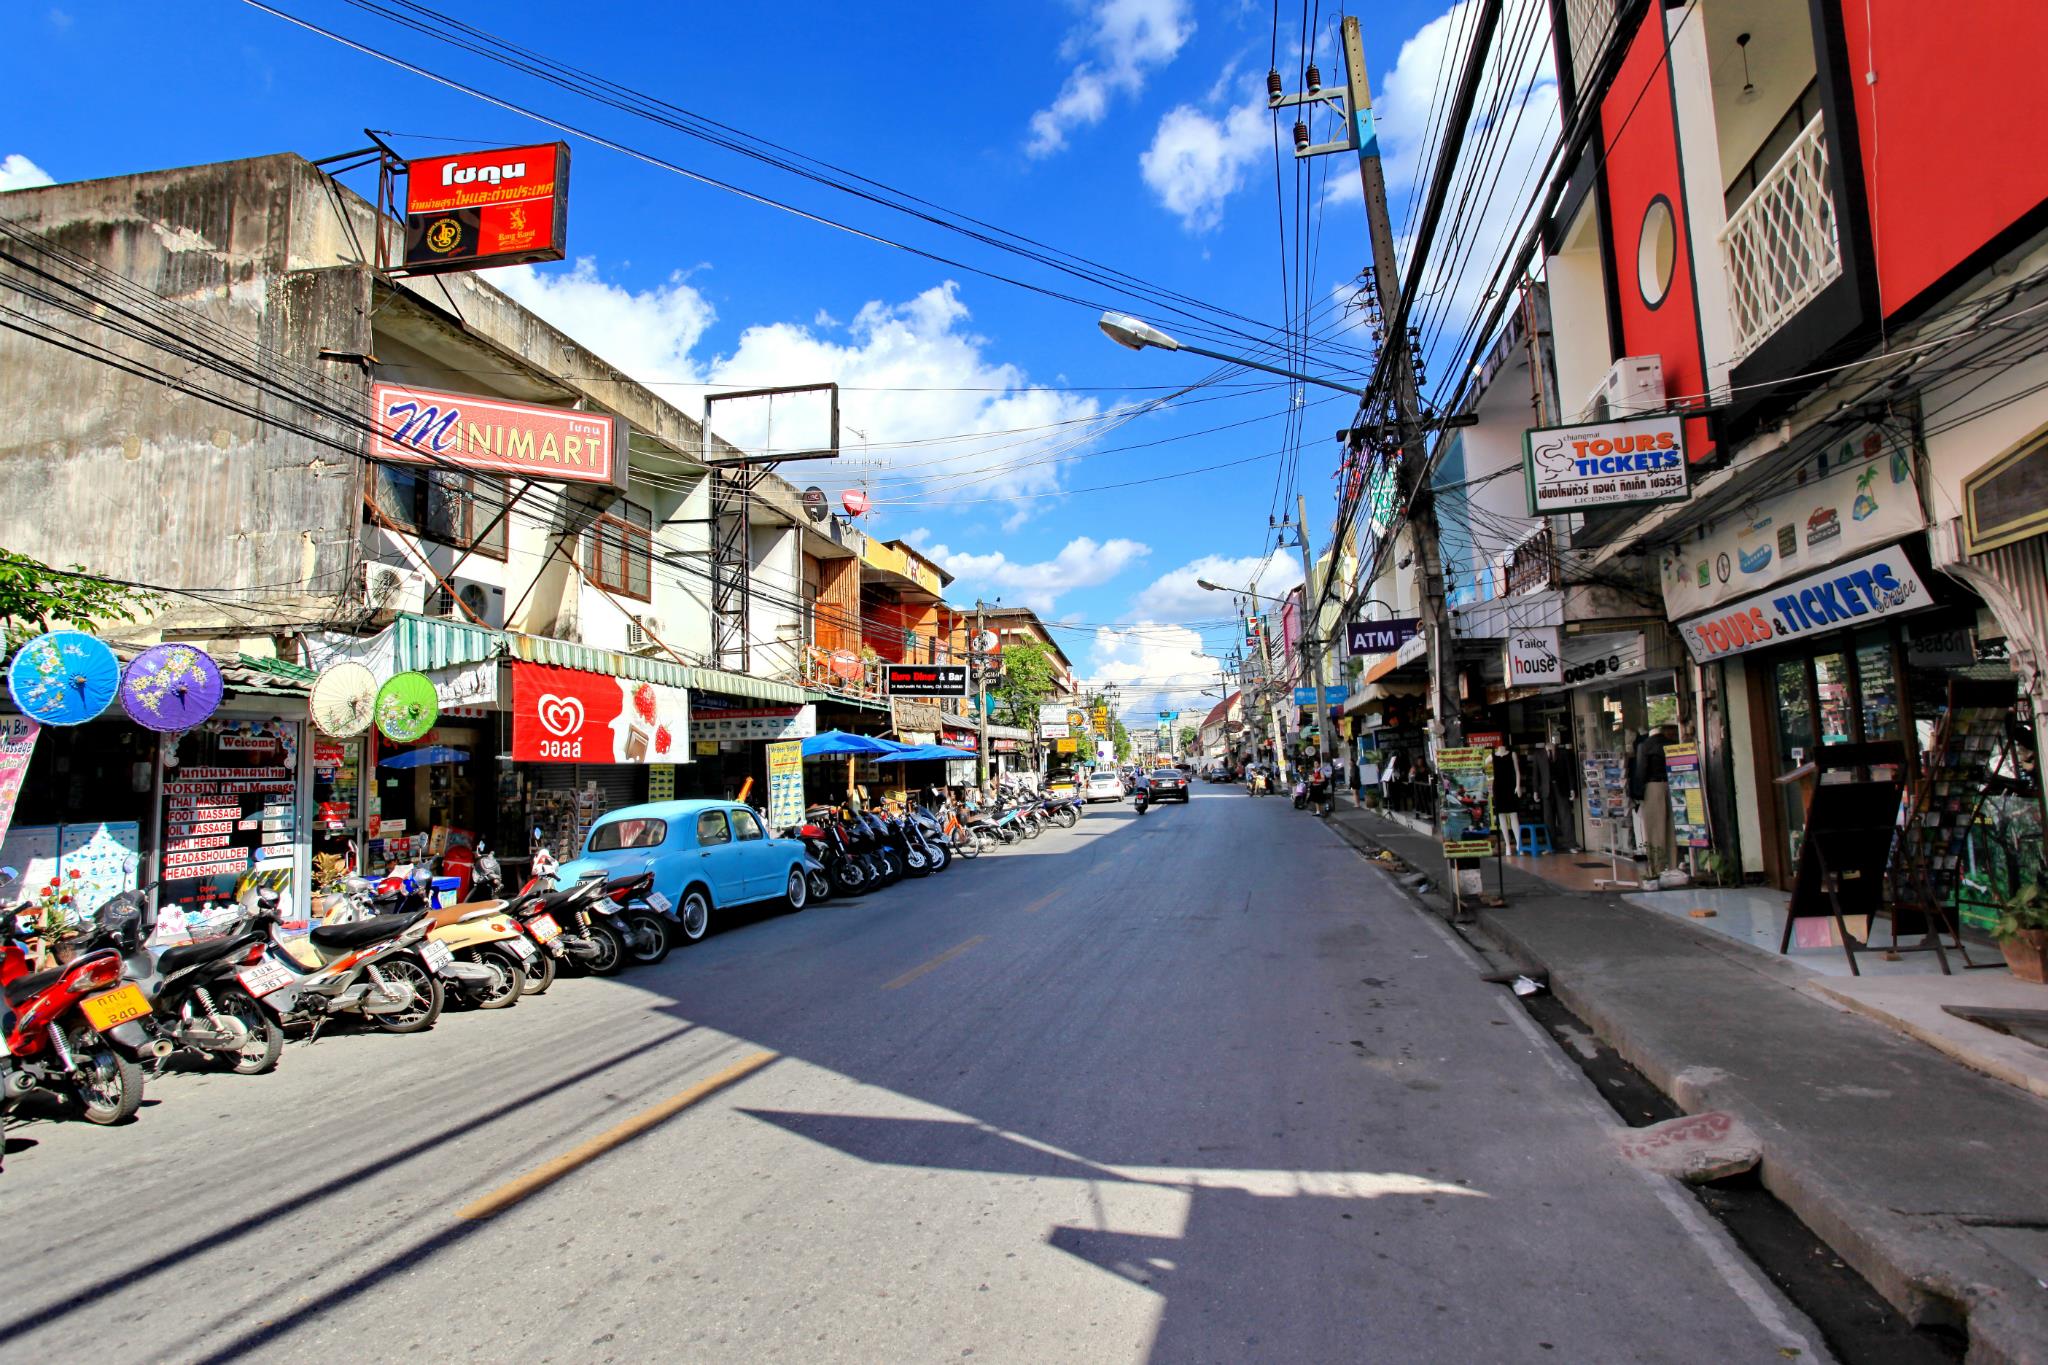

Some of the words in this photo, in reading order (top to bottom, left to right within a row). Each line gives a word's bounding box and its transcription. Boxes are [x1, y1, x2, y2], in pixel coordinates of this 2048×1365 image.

[388, 403, 601, 468] MINIMART
[1572, 432, 1674, 458] TOURS
[1575, 450, 1680, 477] TICKETS
[1574, 494, 1621, 504] LICENSE
[1773, 563, 1902, 632] TICKETS
[1871, 578, 1917, 614] Service
[1696, 607, 1774, 654] TOURS
[1772, 617, 1790, 636] &
[1353, 631, 1395, 649] ATM
[1517, 639, 1548, 649] Tailor
[1515, 656, 1557, 674] house
[1564, 659, 1606, 683] ouse
[913, 672, 937, 681] Diner
[938, 672, 946, 681] &
[949, 672, 964, 681] Bar
[14, 719, 28, 736] Bin
[223, 737, 275, 747] Welcome
[540, 737, 583, 758] วอลล์
[163, 783, 217, 794] NOKBIN
[222, 782, 249, 793] Thai
[249, 782, 295, 794] Massage
[170, 797, 193, 807] THAI
[195, 795, 239, 806] MASSAGE
[169, 811, 194, 821] FOOT
[197, 808, 241, 819] MASSAGE
[169, 825, 185, 836] OIL
[188, 822, 232, 834] MASSAGE
[168, 840, 190, 849] THAI
[193, 836, 230, 847] HERBEL
[168, 848, 248, 864] HEAD&SHOULDER
[167, 862, 247, 879] HEAD&SHOULDER
[108, 1007, 138, 1023] 240
